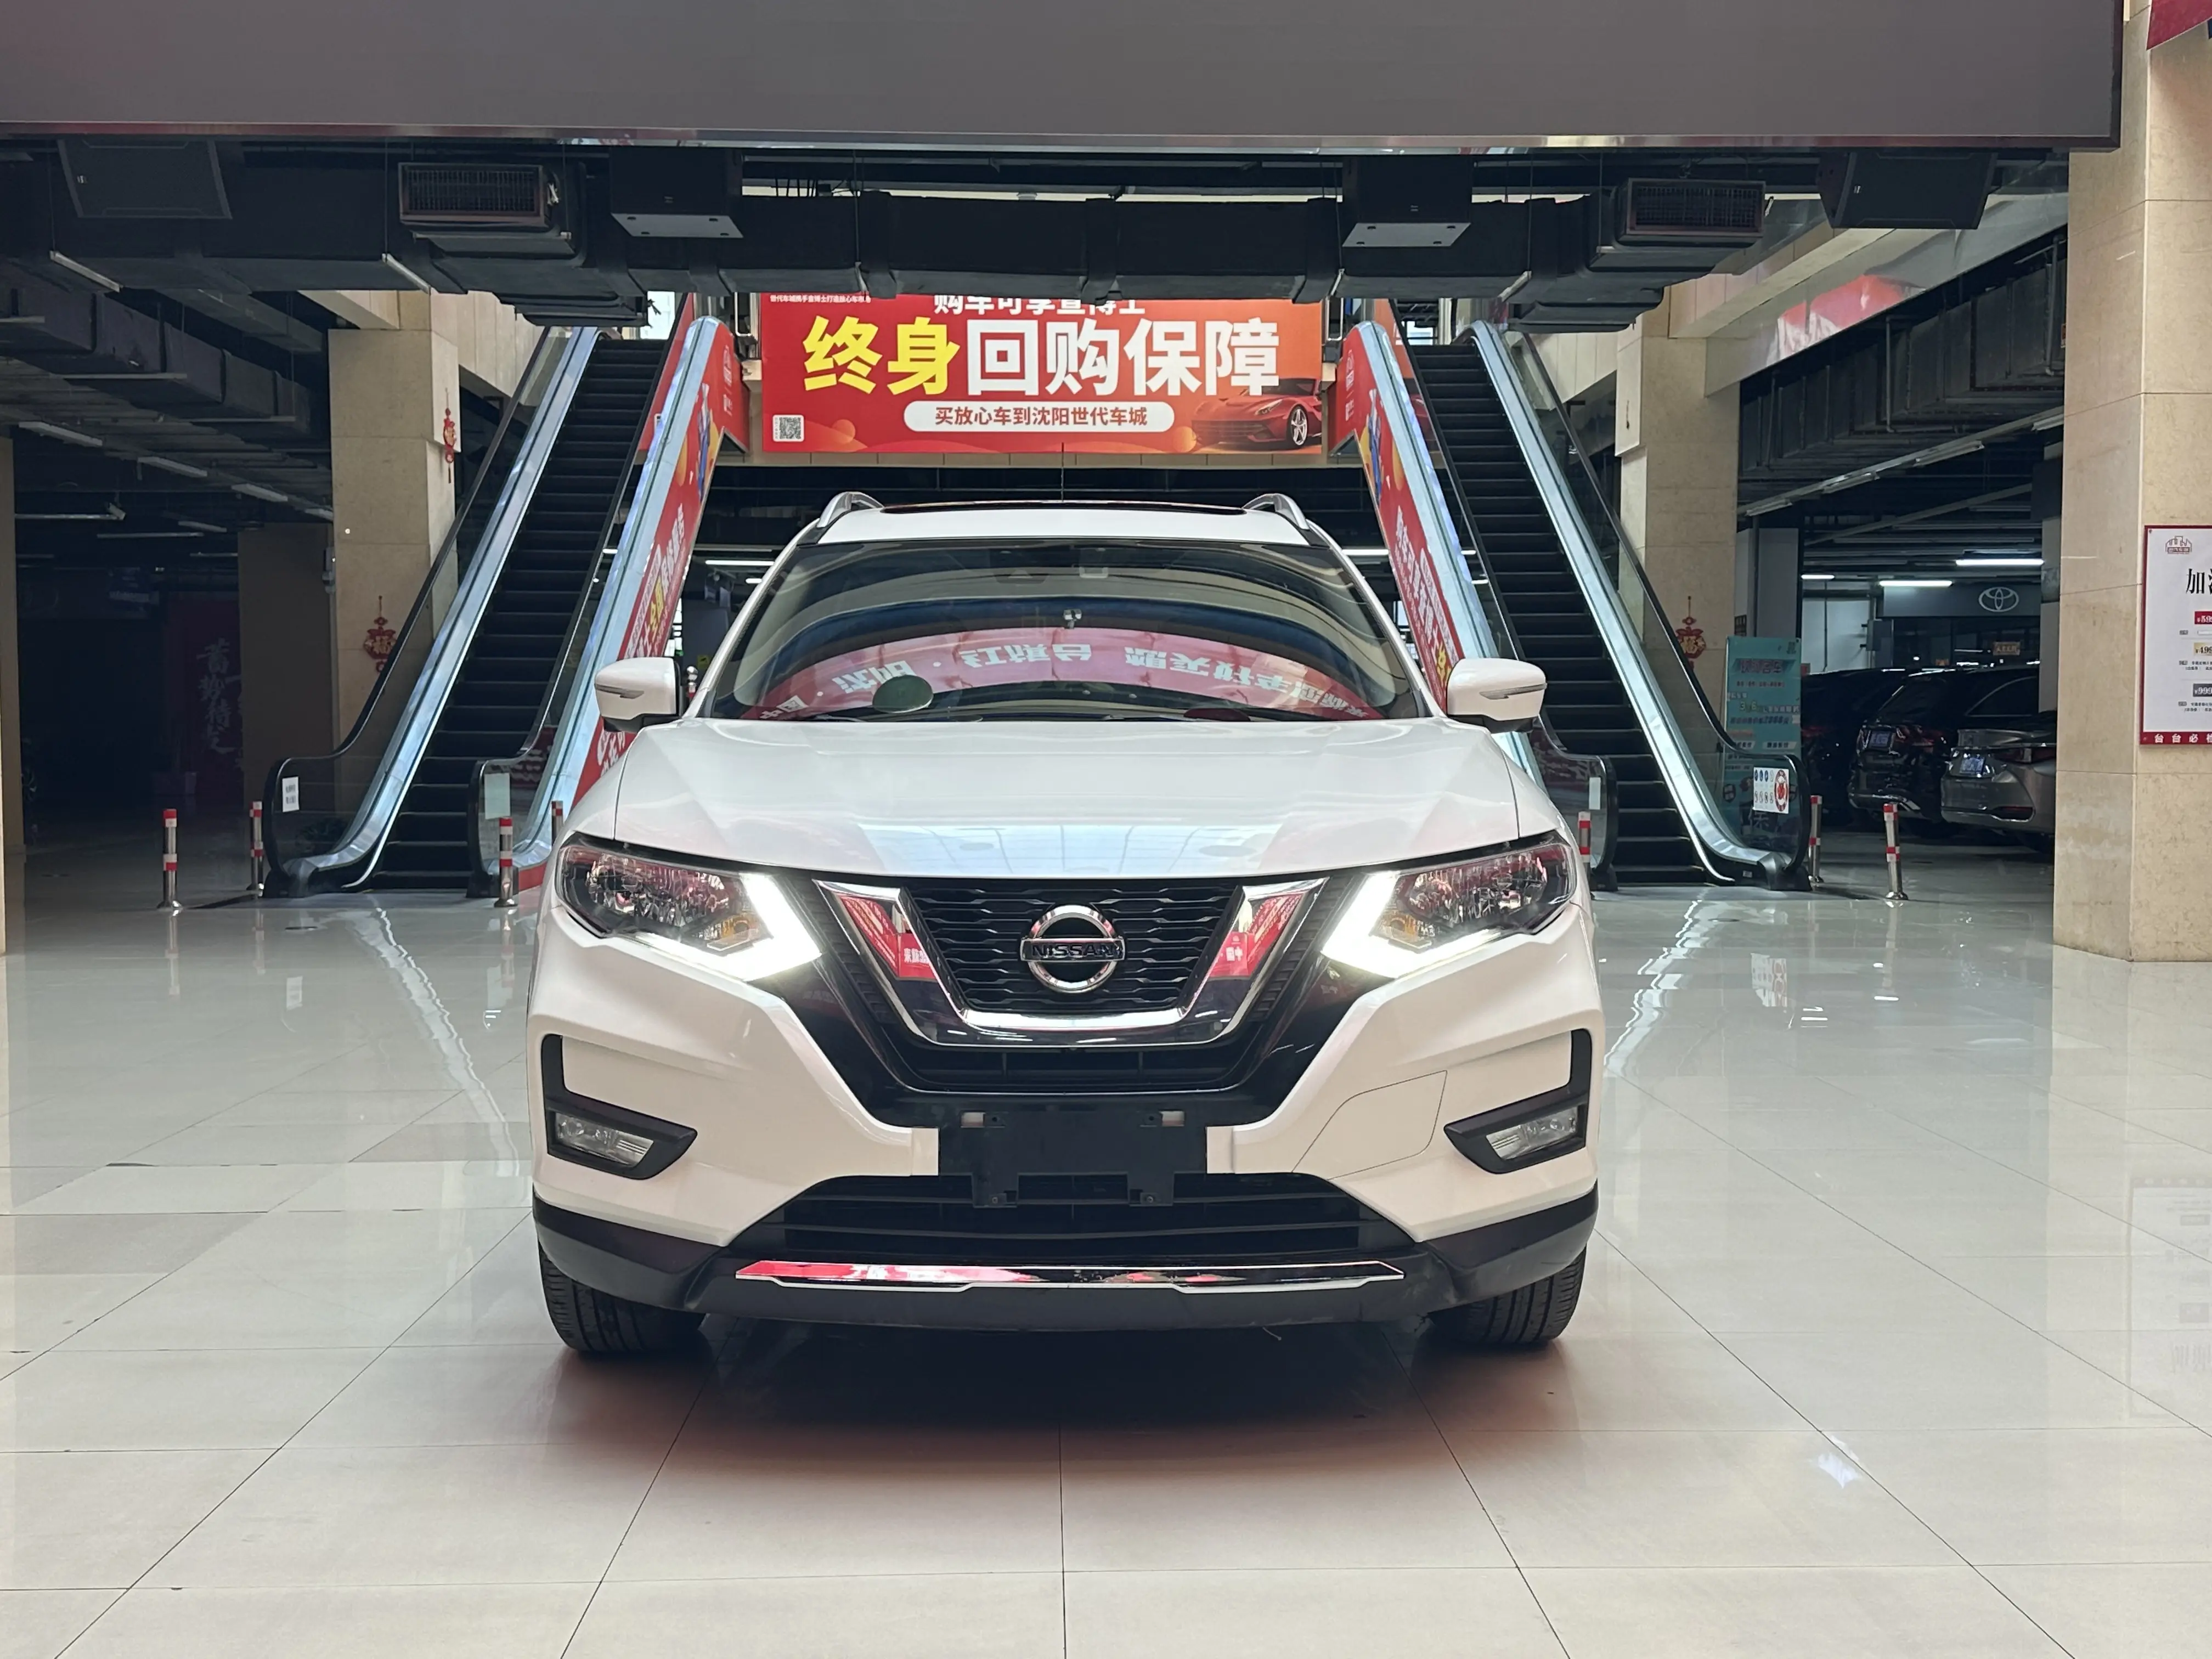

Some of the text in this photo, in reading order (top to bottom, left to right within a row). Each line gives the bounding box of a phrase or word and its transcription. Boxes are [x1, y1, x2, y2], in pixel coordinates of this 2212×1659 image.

[803, 315, 1279, 396] 终身回购保障
[935, 406, 1147, 427] 买放心车到沈阳世代车城
[2186, 568, 2212, 594] 加
[1031, 944, 1114, 958] NISSAN
